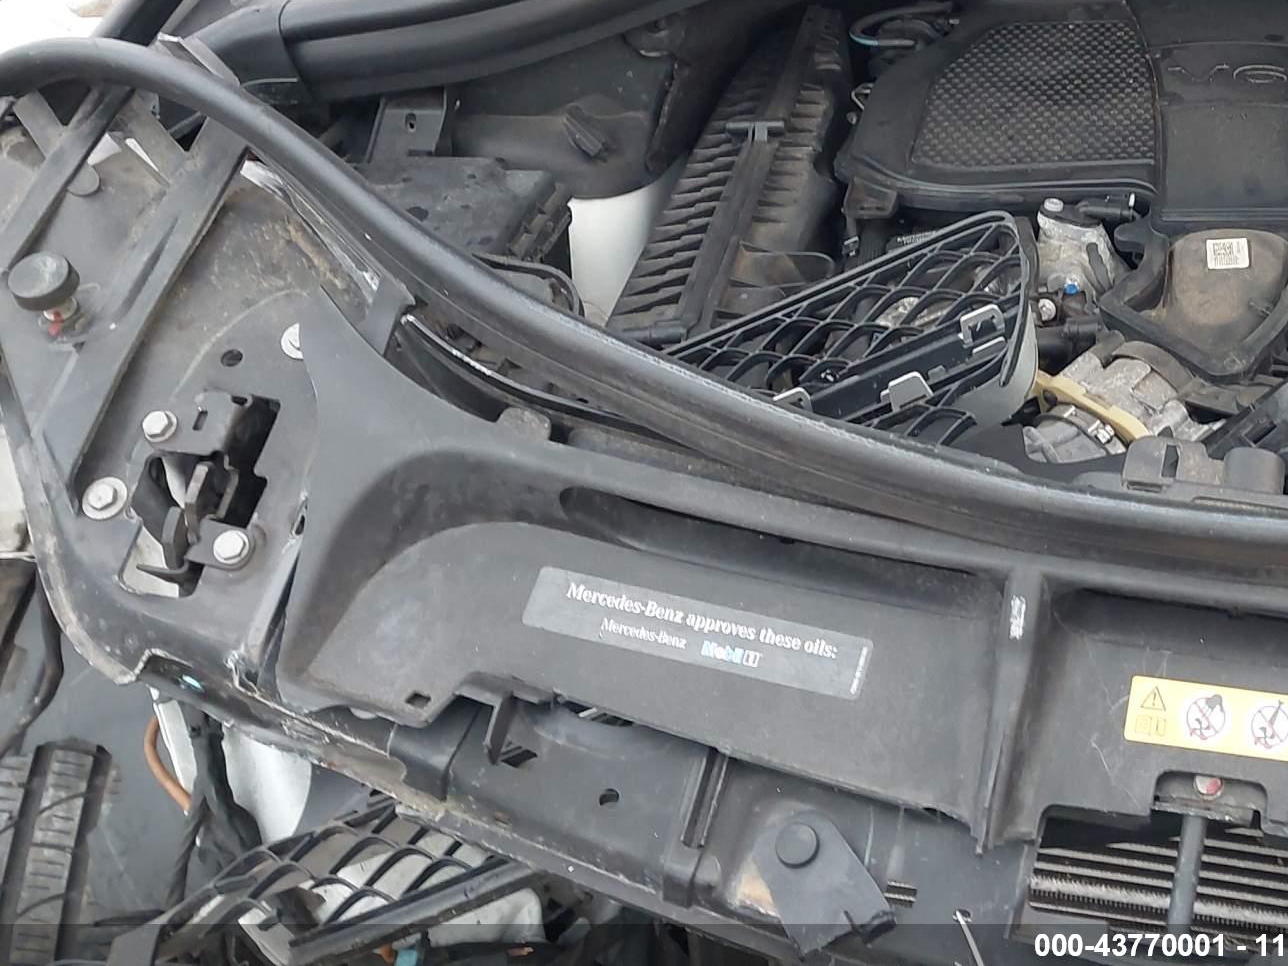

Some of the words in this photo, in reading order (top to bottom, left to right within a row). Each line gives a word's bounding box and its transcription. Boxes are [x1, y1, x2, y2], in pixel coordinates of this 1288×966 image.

[566, 582, 684, 624] Mercedes-Benz
[686, 613, 757, 641] approves
[759, 627, 801, 651] these
[803, 638, 838, 659] oils:
[600, 617, 688, 650] Mercedes-Benz
